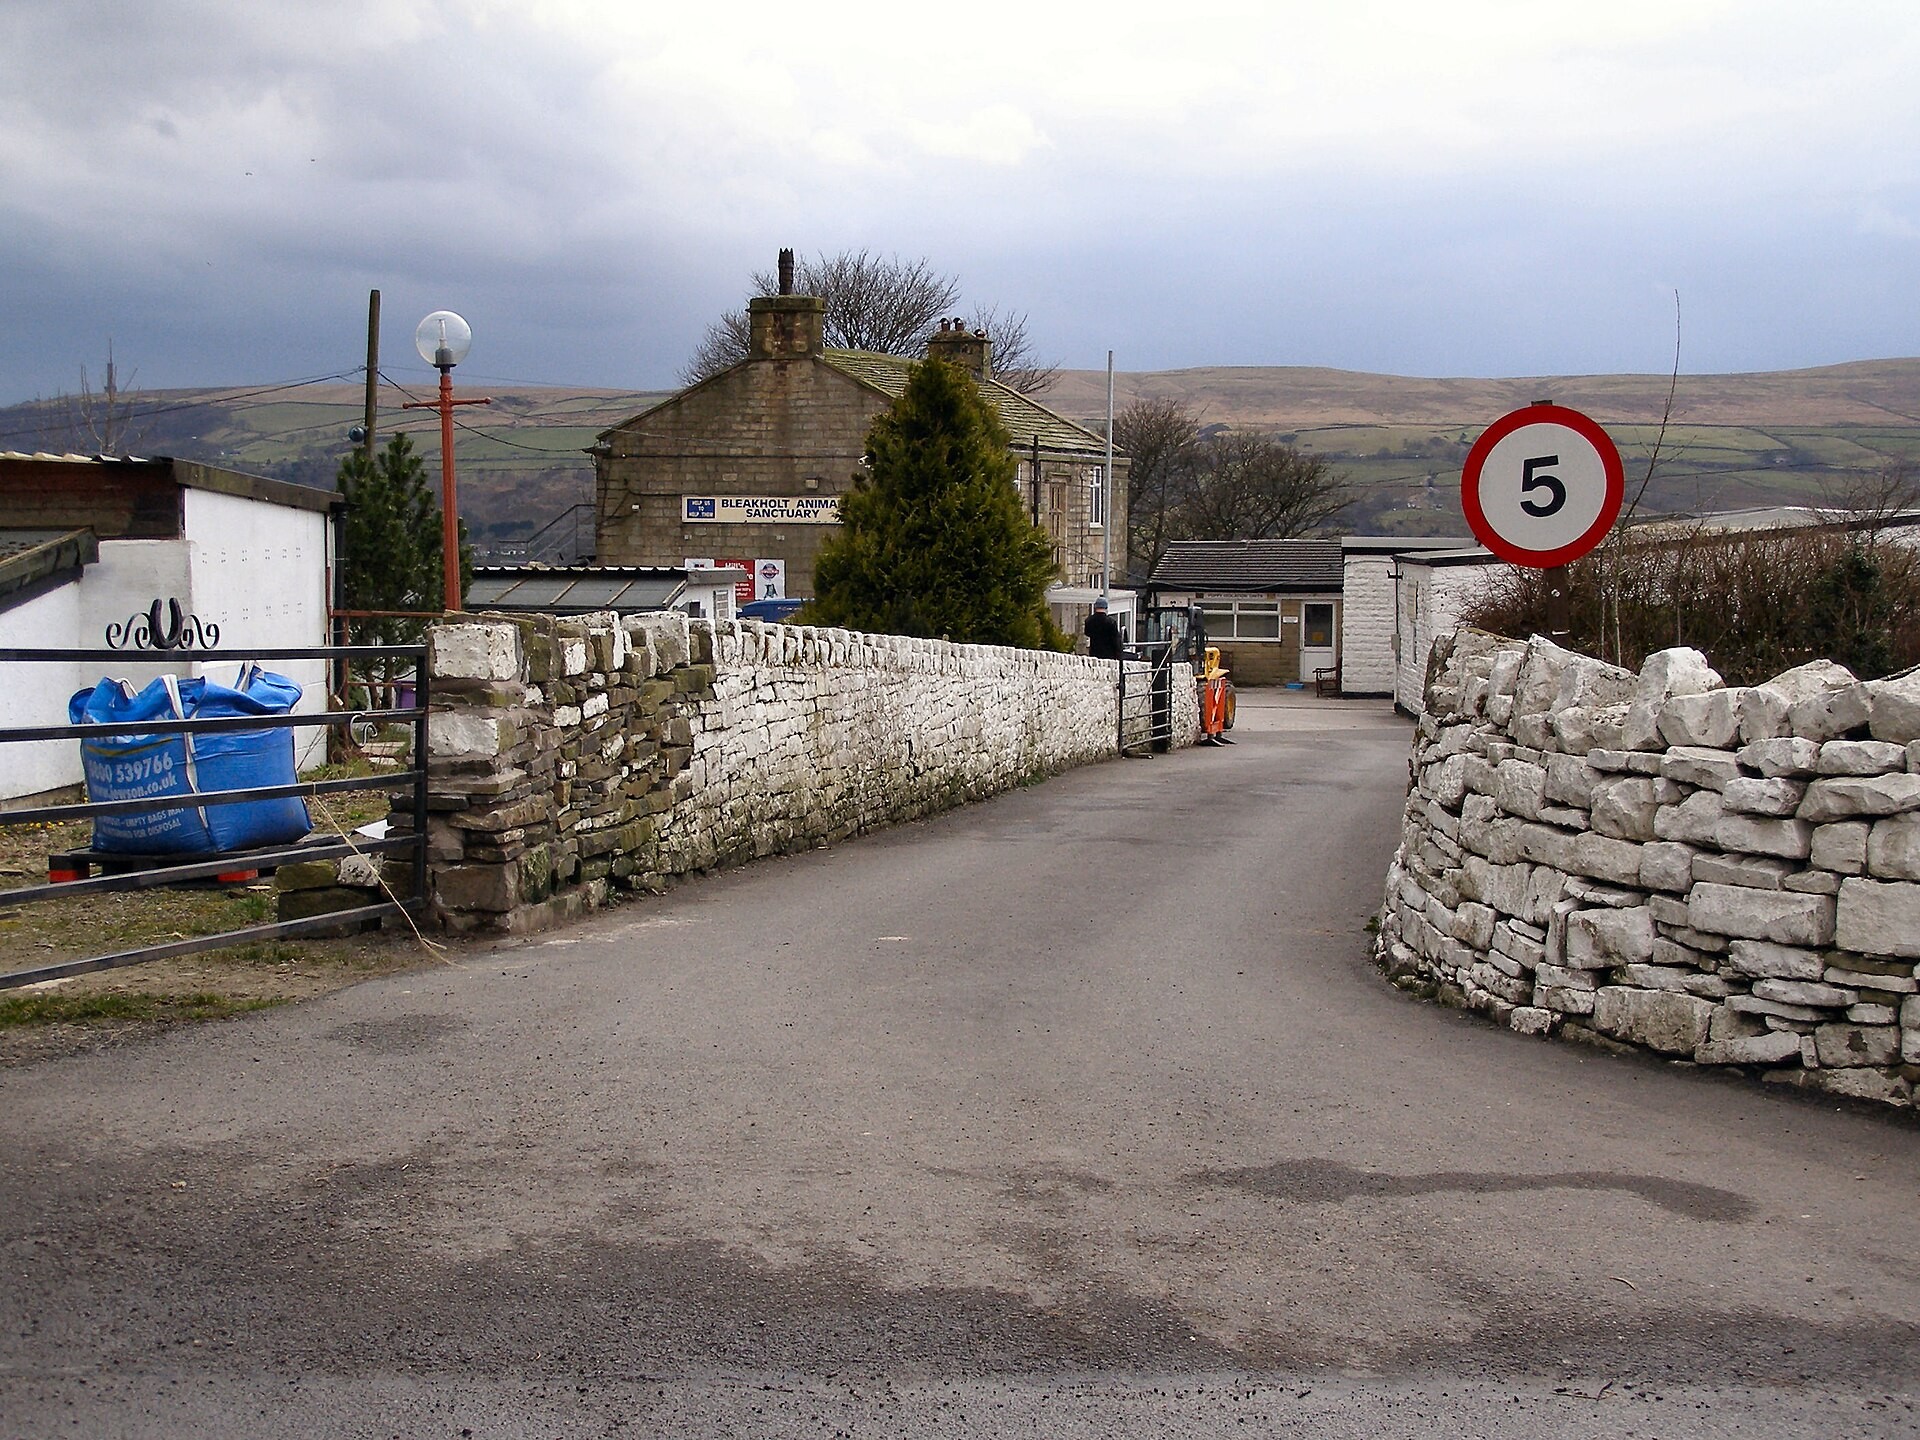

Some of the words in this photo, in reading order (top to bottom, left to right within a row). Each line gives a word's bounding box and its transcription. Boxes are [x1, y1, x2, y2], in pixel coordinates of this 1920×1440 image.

[1520, 455, 1566, 517] 5
[721, 499, 790, 508] BLEAKHOLT
[796, 499, 838, 508] ANIMA
[746, 508, 820, 518] SANCTUARY
[116, 751, 173, 782] 539766
